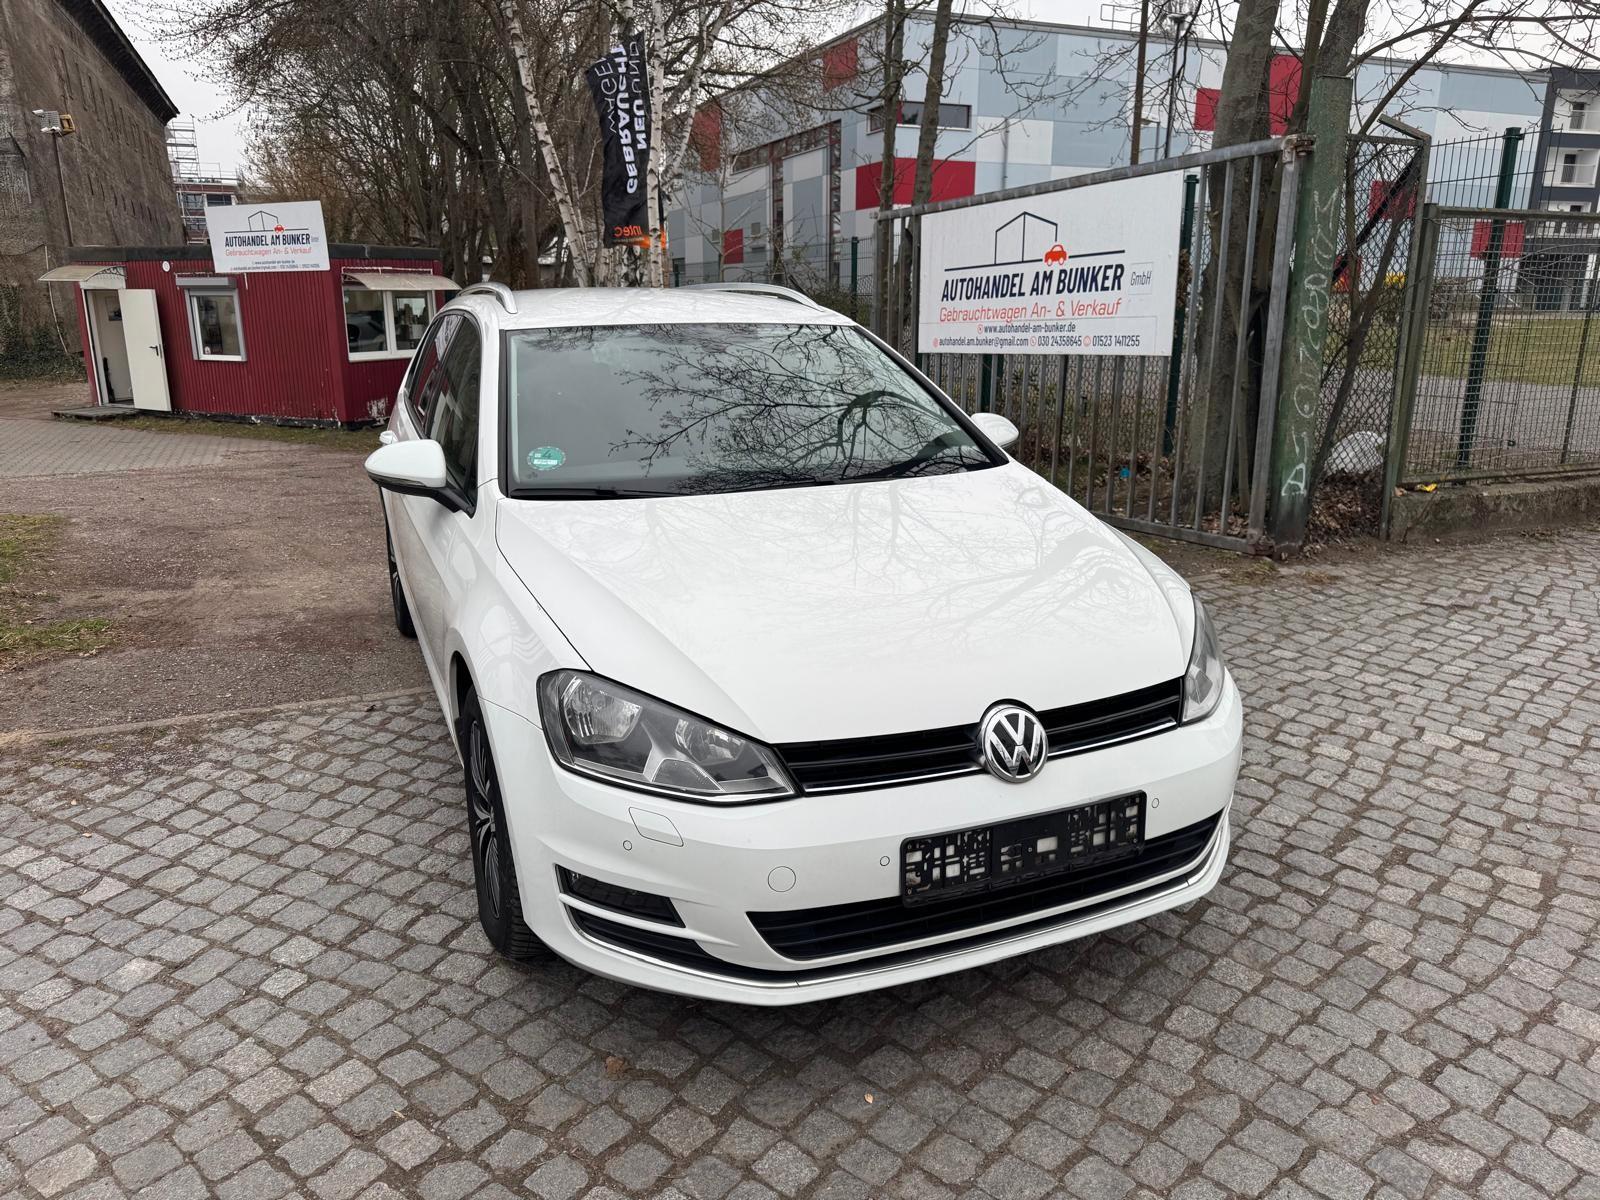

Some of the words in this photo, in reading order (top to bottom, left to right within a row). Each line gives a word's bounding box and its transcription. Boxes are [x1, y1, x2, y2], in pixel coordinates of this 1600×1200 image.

[225, 235, 269, 247] AUTOHANDEL
[270, 234, 280, 245] AM
[282, 234, 310, 245] BUNKER
[225, 249, 271, 257] Gebrauchtwagen
[941, 272, 1026, 303] AUTOHANDEL
[1029, 269, 1054, 297] AM
[1055, 263, 1126, 295] BUNKER
[1130, 269, 1153, 287] GmbH
[939, 305, 1027, 324] Gebrauchtwagen
[1031, 301, 1052, 318] An-
[1055, 300, 1066, 317] &
[1070, 297, 1123, 316] Verkauf
[984, 322, 1076, 335] www.autohandel-am-bunker.de
[939, 335, 1029, 349] autohandel.am.bunker@gmail.com
[1037, 335, 1049, 347] 030
[1092, 335, 1112, 347] 01523
[986, 708, 1045, 779] VW
